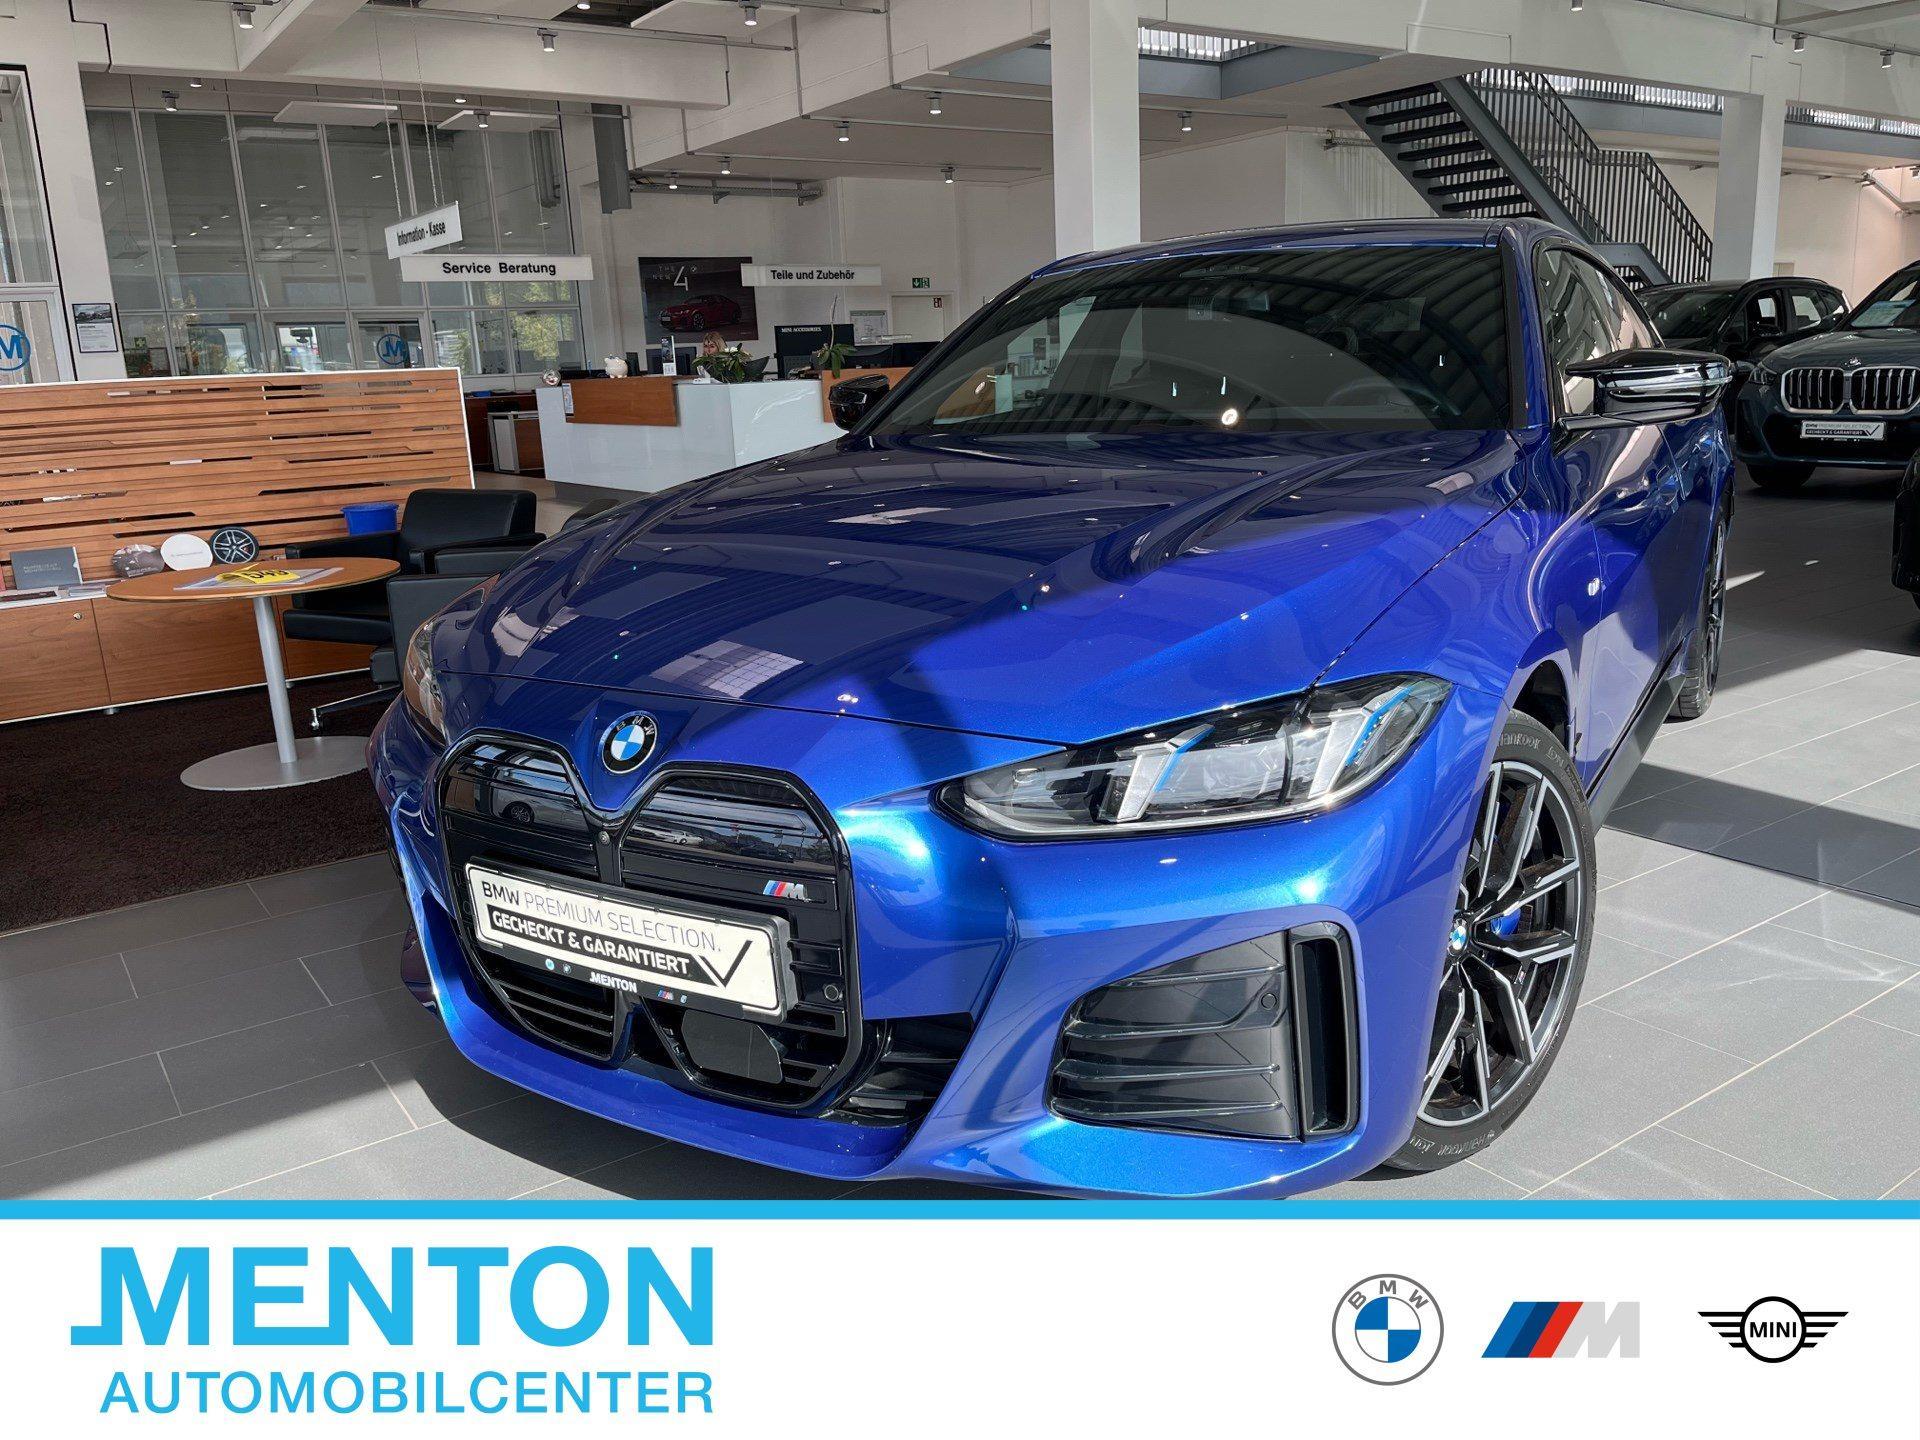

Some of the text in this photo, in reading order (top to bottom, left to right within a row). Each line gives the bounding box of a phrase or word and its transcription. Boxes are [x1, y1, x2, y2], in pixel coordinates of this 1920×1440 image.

[428, 222, 446, 237] Kasse
[442, 262, 556, 276] Service Beratung
[673, 266, 689, 291] 4
[770, 269, 855, 280] Teile und Zubehör
[615, 715, 655, 736] BMW
[481, 880, 520, 906] BMW
[524, 891, 604, 928] PREMIUM
[492, 910, 690, 974] GECHECKT & GARANTIERT
[589, 971, 638, 994] MENTON
